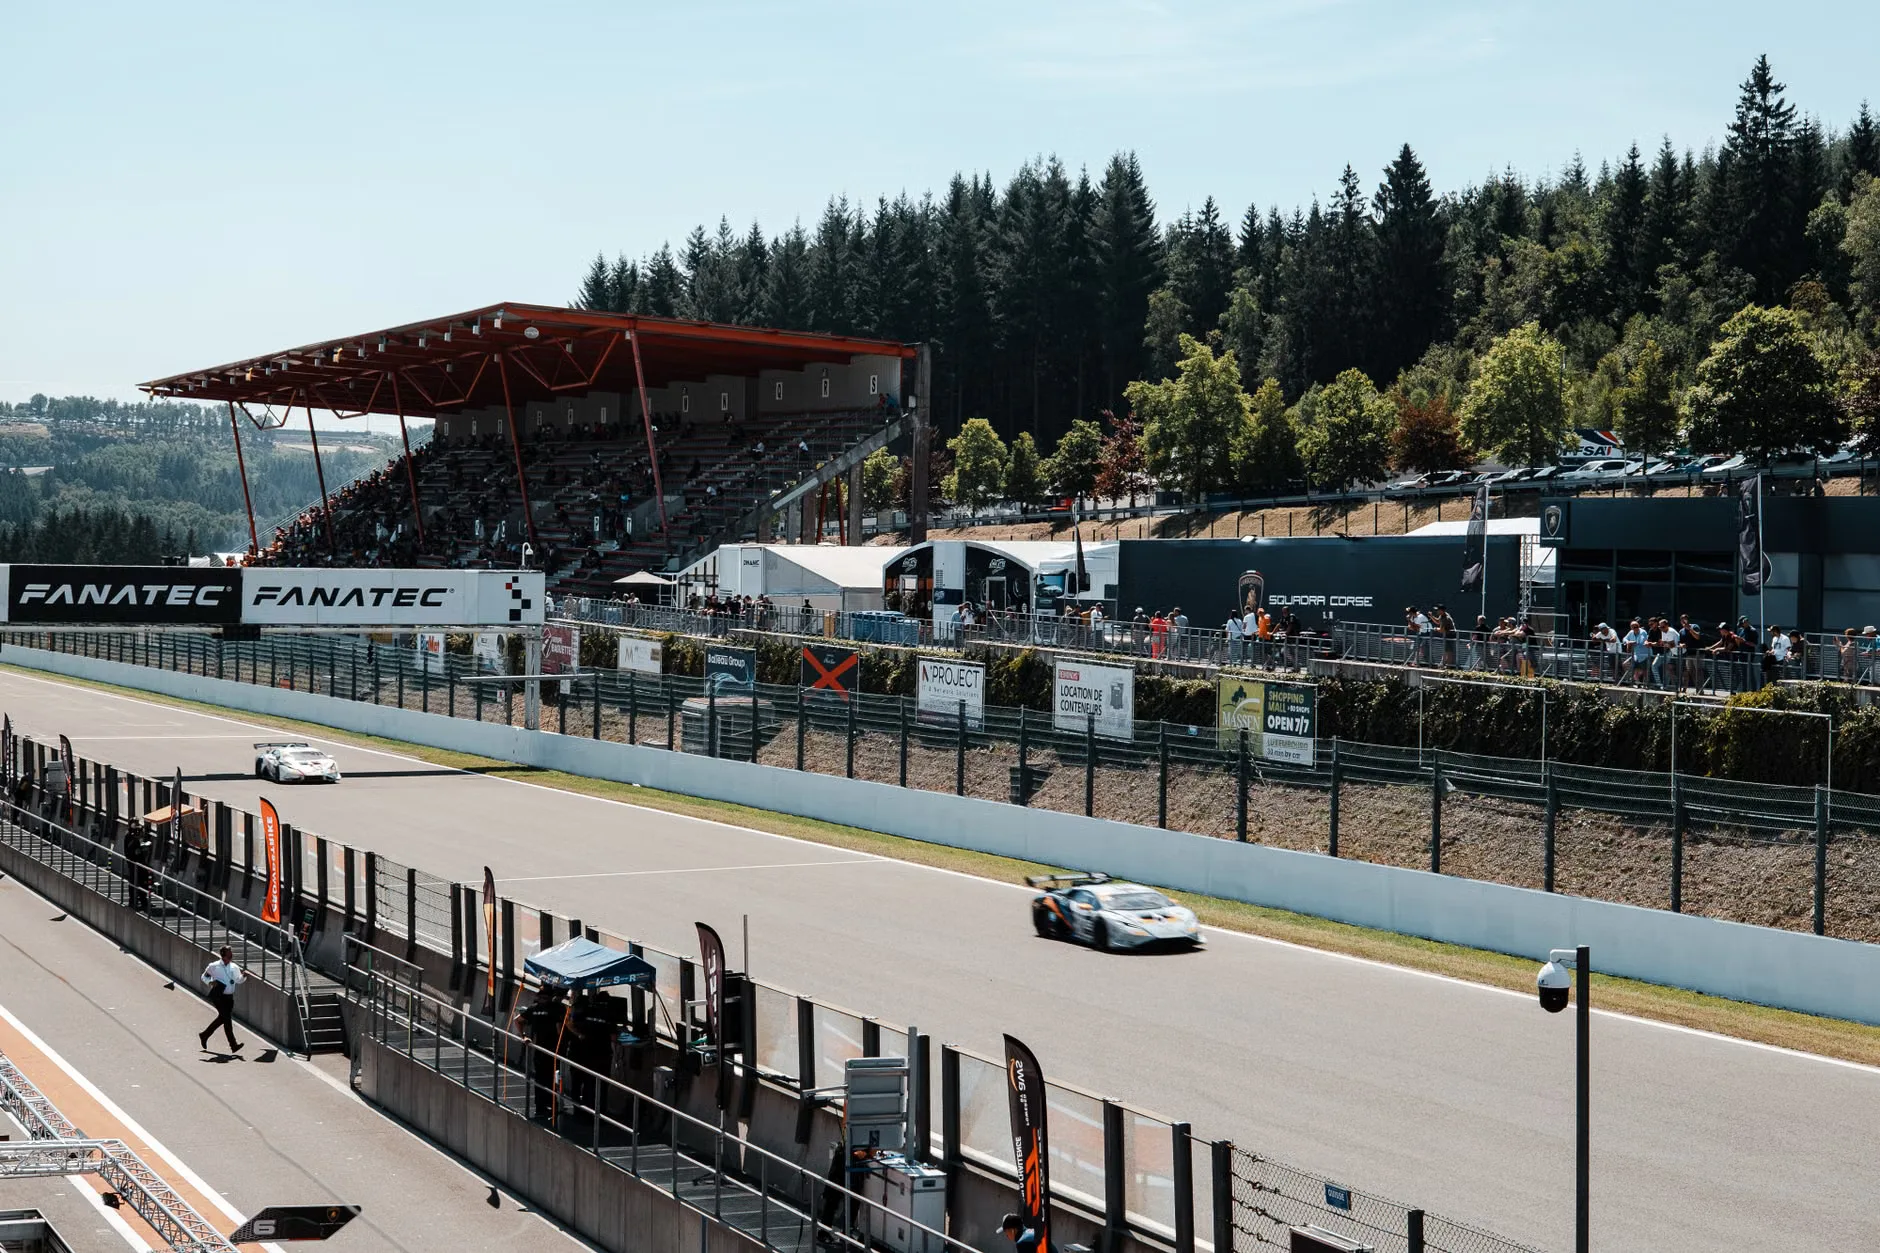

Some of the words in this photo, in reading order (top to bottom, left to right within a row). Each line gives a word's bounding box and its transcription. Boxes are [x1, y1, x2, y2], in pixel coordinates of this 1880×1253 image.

[1268, 595, 1326, 606] SQUADRA
[1329, 596, 1373, 607] CORSE
[728, 655, 746, 669] Group
[1060, 684, 1093, 701] LOCATION
[1093, 689, 1103, 702] DE
[1268, 690, 1305, 705] SHOPPING
[1060, 699, 1103, 716] CONTENEURS
[1267, 701, 1287, 713] MALL
[1222, 711, 1262, 730] MASSEN
[1267, 714, 1294, 732] OPEN
[1294, 715, 1310, 735] 7/7
[253, 1219, 277, 1236] 6
